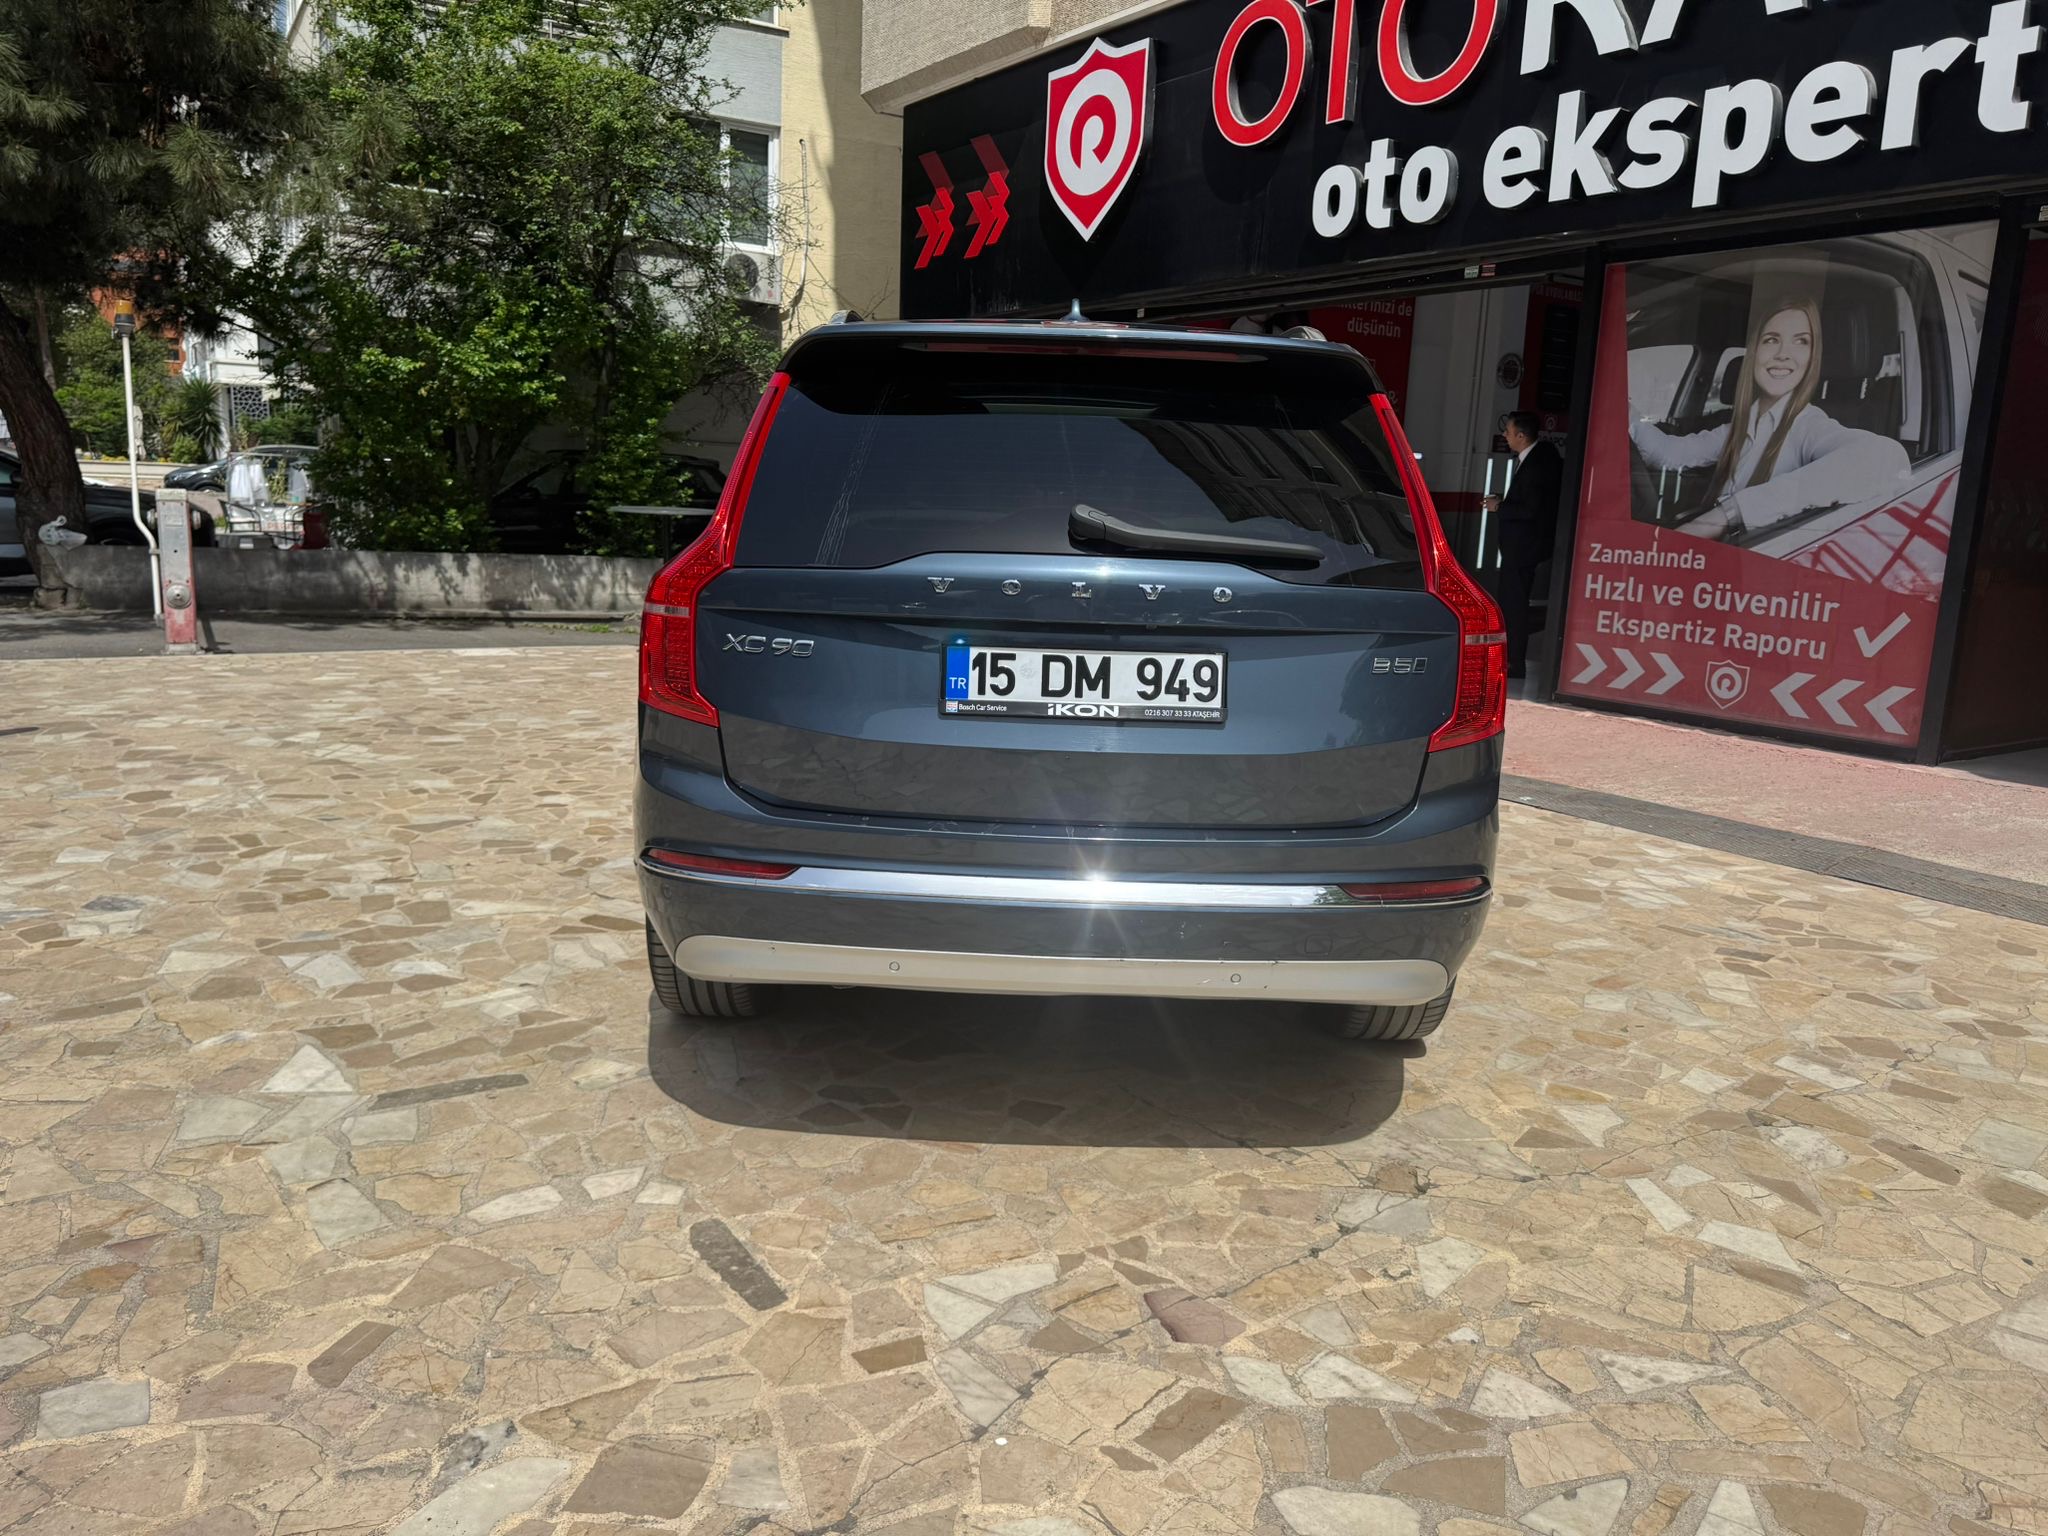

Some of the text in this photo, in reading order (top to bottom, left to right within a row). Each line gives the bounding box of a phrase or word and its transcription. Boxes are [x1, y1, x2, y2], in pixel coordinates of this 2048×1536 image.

[1311, 0, 2042, 239] oto ekspert
[1397, 300, 1413, 316] de
[1347, 317, 1401, 337] düşünün
[1589, 543, 1706, 569] Zamanında
[927, 576, 1233, 602] VOLVO
[1584, 574, 1840, 623] Hızlı ve Güvenilir
[1596, 611, 1827, 660] Ekspertiz Raporu
[949, 652, 1219, 702] TR 15 DM 949
[958, 703, 976, 711] Bosch
[986, 704, 1008, 712] Service
[1161, 709, 1174, 717] 307
